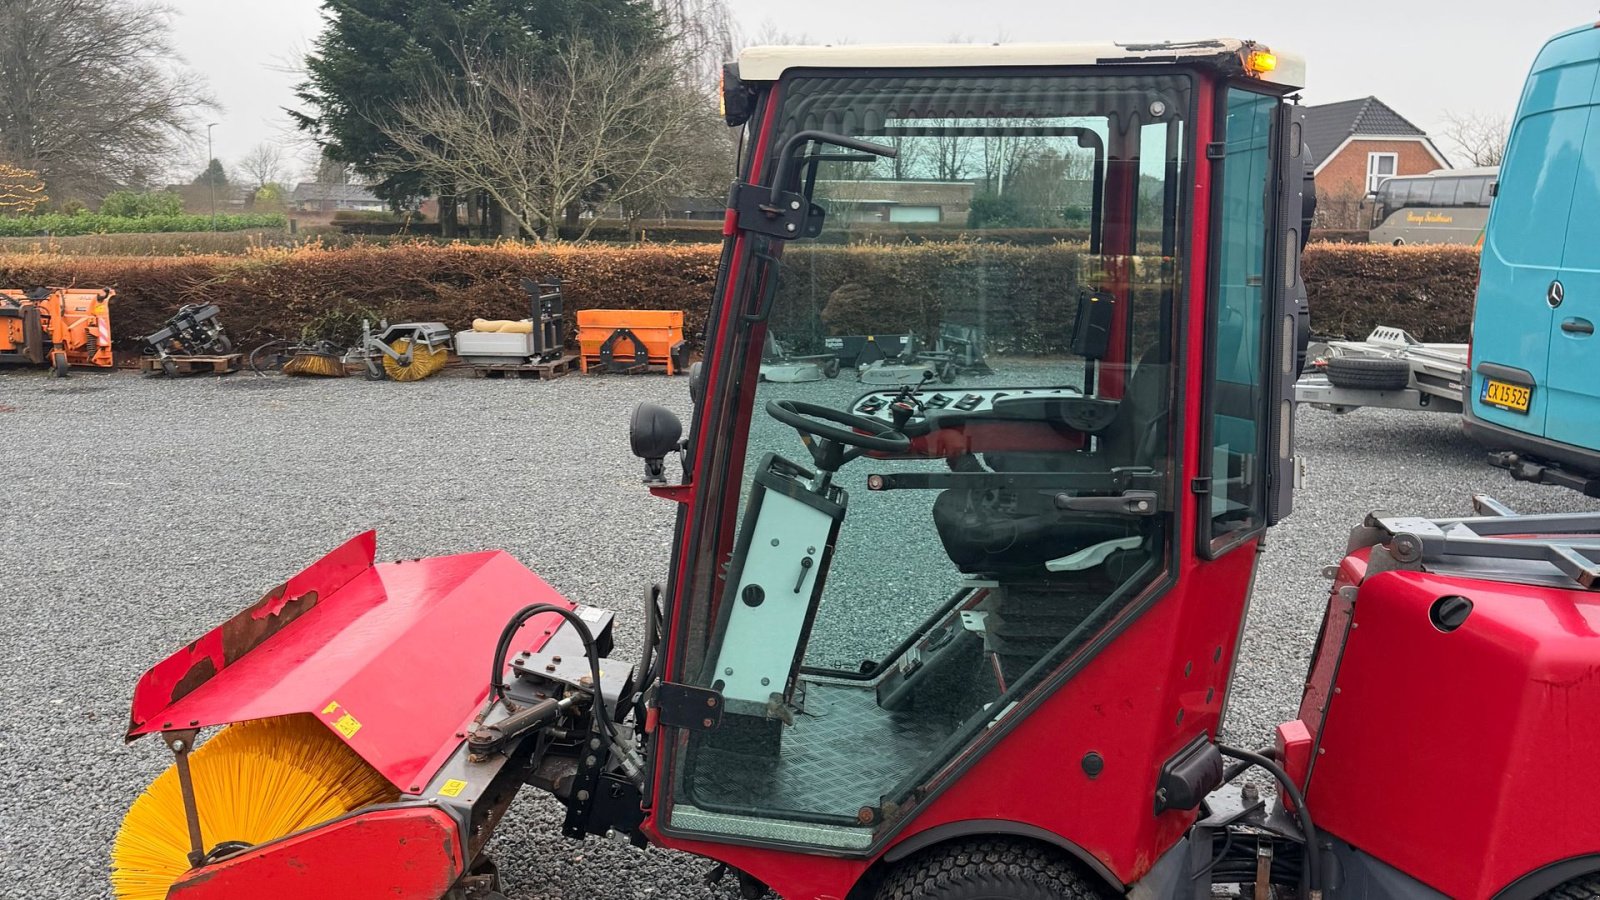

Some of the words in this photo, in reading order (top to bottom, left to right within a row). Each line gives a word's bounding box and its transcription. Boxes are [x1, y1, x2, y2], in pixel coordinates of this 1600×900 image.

[1488, 383, 1499, 400] CX
[1500, 386, 1511, 402] 15
[1511, 388, 1528, 406] 525
